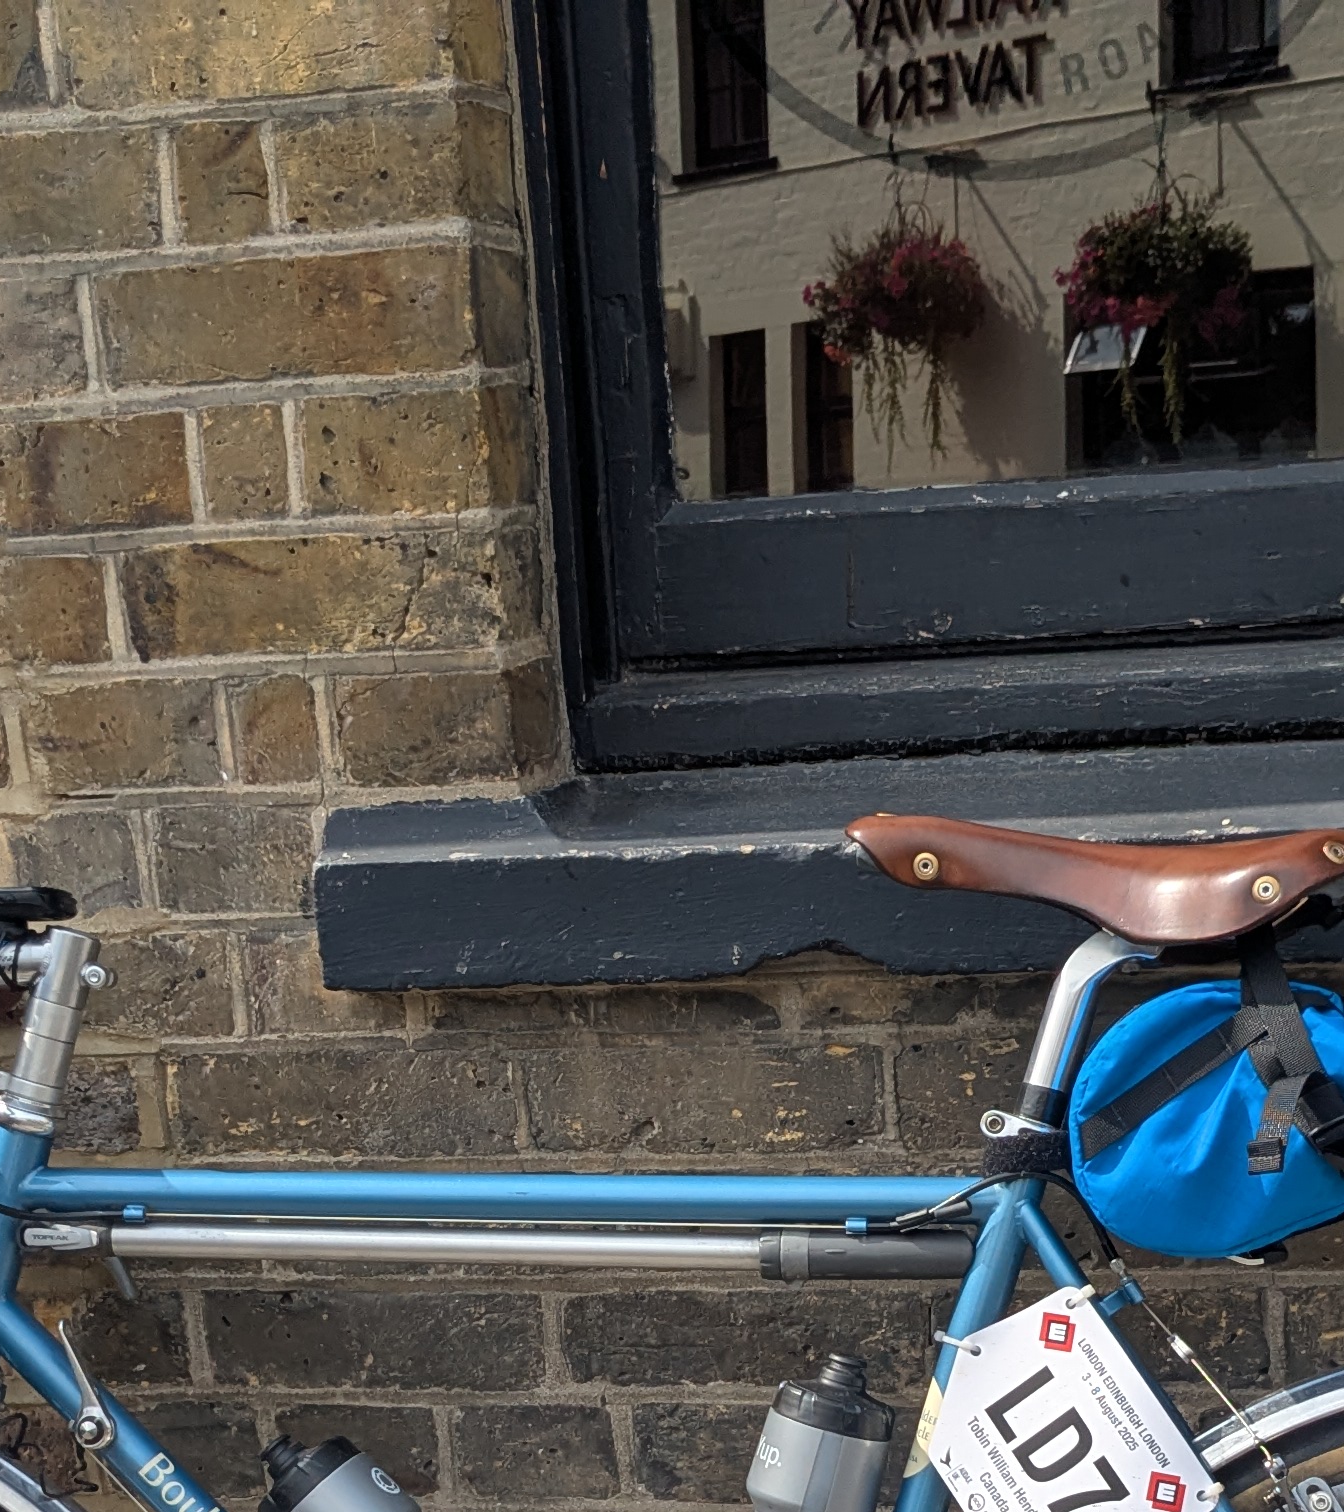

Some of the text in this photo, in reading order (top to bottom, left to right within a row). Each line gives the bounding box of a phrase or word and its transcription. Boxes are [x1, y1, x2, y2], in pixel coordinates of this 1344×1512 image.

[31, 1233, 69, 1242] TOPEAK
[1078, 1338, 1171, 1469] LONDON EDINBURGH LONDON
[1082, 1372, 1092, 1382] 3
[1091, 1386, 1101, 1396] 8
[1096, 1394, 1123, 1429] August
[1118, 1426, 1140, 1452] 2025
[967, 1416, 991, 1448] Tobin
[987, 1446, 1017, 1489] William
